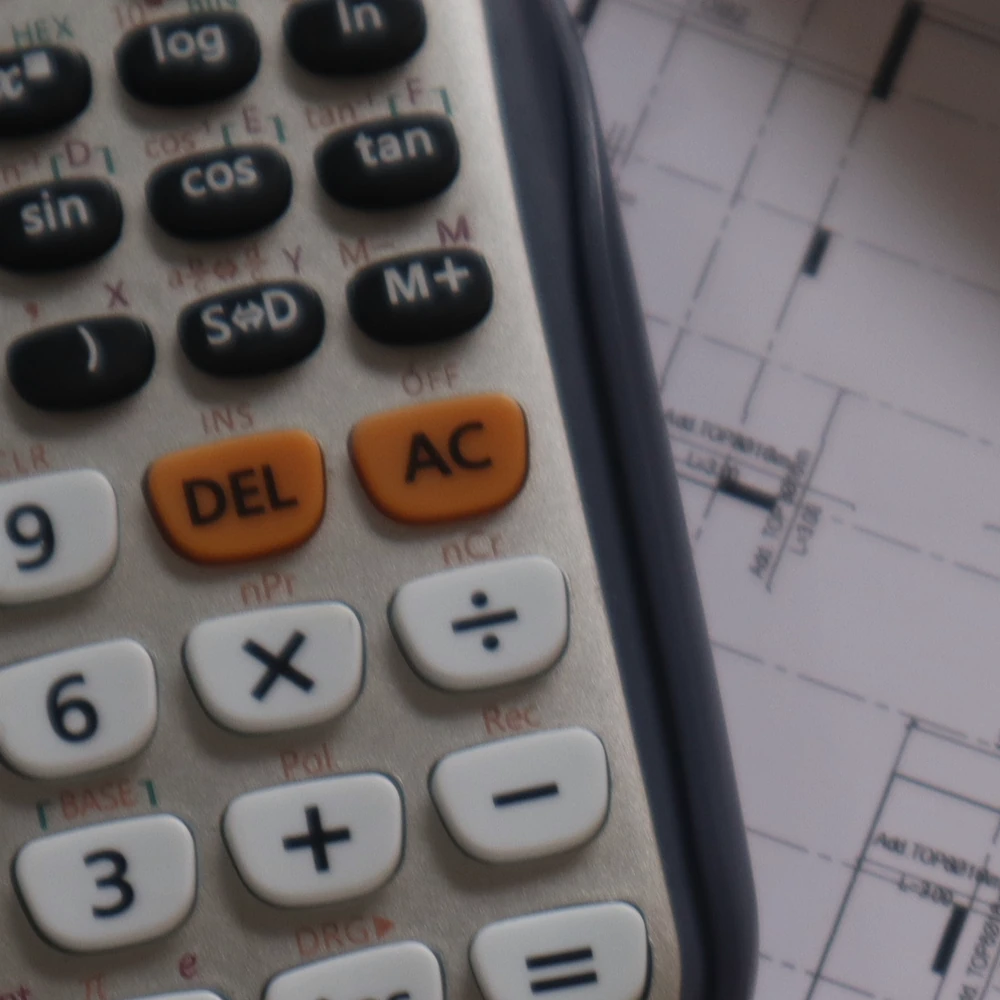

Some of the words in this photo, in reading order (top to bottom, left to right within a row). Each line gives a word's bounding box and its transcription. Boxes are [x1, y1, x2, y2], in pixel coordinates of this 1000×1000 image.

[12, 15, 75, 48] HEX
[150, 23, 227, 66] log
[404, 76, 423, 107] F
[243, 105, 263, 134] E
[64, 139, 91, 167] D
[354, 124, 434, 169] tan
[181, 154, 259, 199] cos
[20, 187, 90, 236] sin
[435, 214, 471, 248] M
[383, 256, 471, 307] M+
[402, 366, 459, 394] OFF
[200, 406, 255, 436] INS
[404, 420, 492, 484] AC
[181, 463, 299, 527] DEL
[5, 504, 56, 572] 9
[441, 534, 503, 565] nCr
[240, 573, 297, 606] nPr
[45, 673, 100, 744] 6
[482, 704, 541, 735] Rec
[279, 746, 334, 781] Pol
[82, 849, 136, 919] 3
